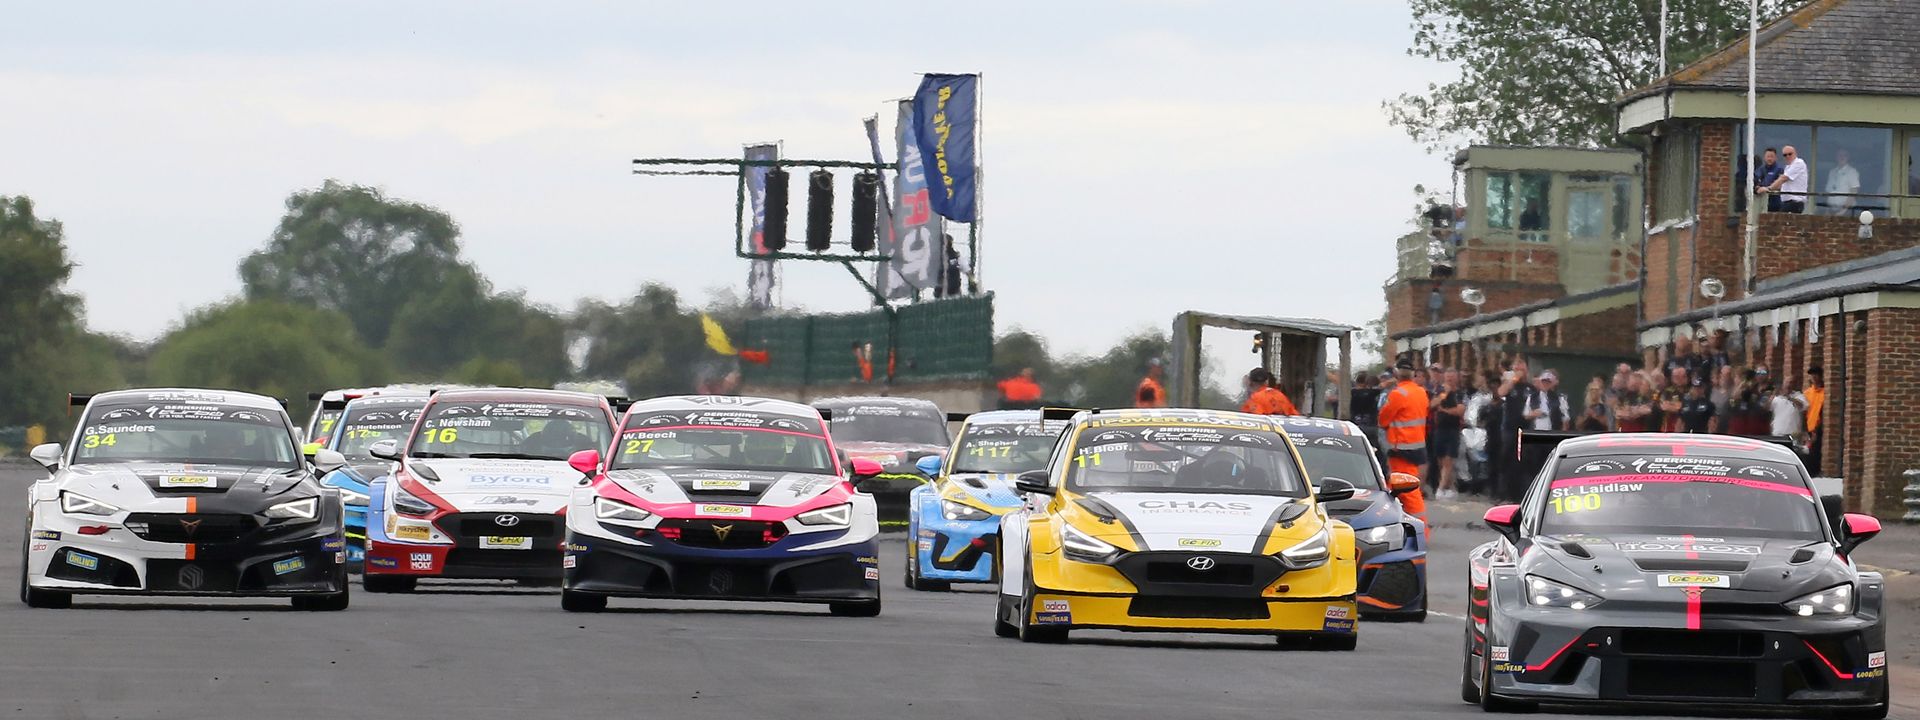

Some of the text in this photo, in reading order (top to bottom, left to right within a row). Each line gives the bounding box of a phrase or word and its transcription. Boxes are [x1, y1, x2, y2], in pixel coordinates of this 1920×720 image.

[425, 418, 491, 428] C. Newsham
[85, 424, 156, 434] G.Saunders
[84, 433, 117, 449] 34
[423, 428, 458, 444] 16
[622, 431, 677, 440] W.Beech
[624, 440, 654, 454] 27
[1073, 453, 1101, 468] 11
[1654, 458, 1724, 466] BERKSHIRE
[470, 474, 550, 486] Byford
[1552, 483, 1644, 498] St. Laidlaw
[1138, 500, 1253, 511] CHAS
[1548, 493, 1602, 514] 100
[1691, 544, 1750, 553] BOX
[410, 553, 432, 561] LIQUI
[411, 561, 432, 569] MOLY
